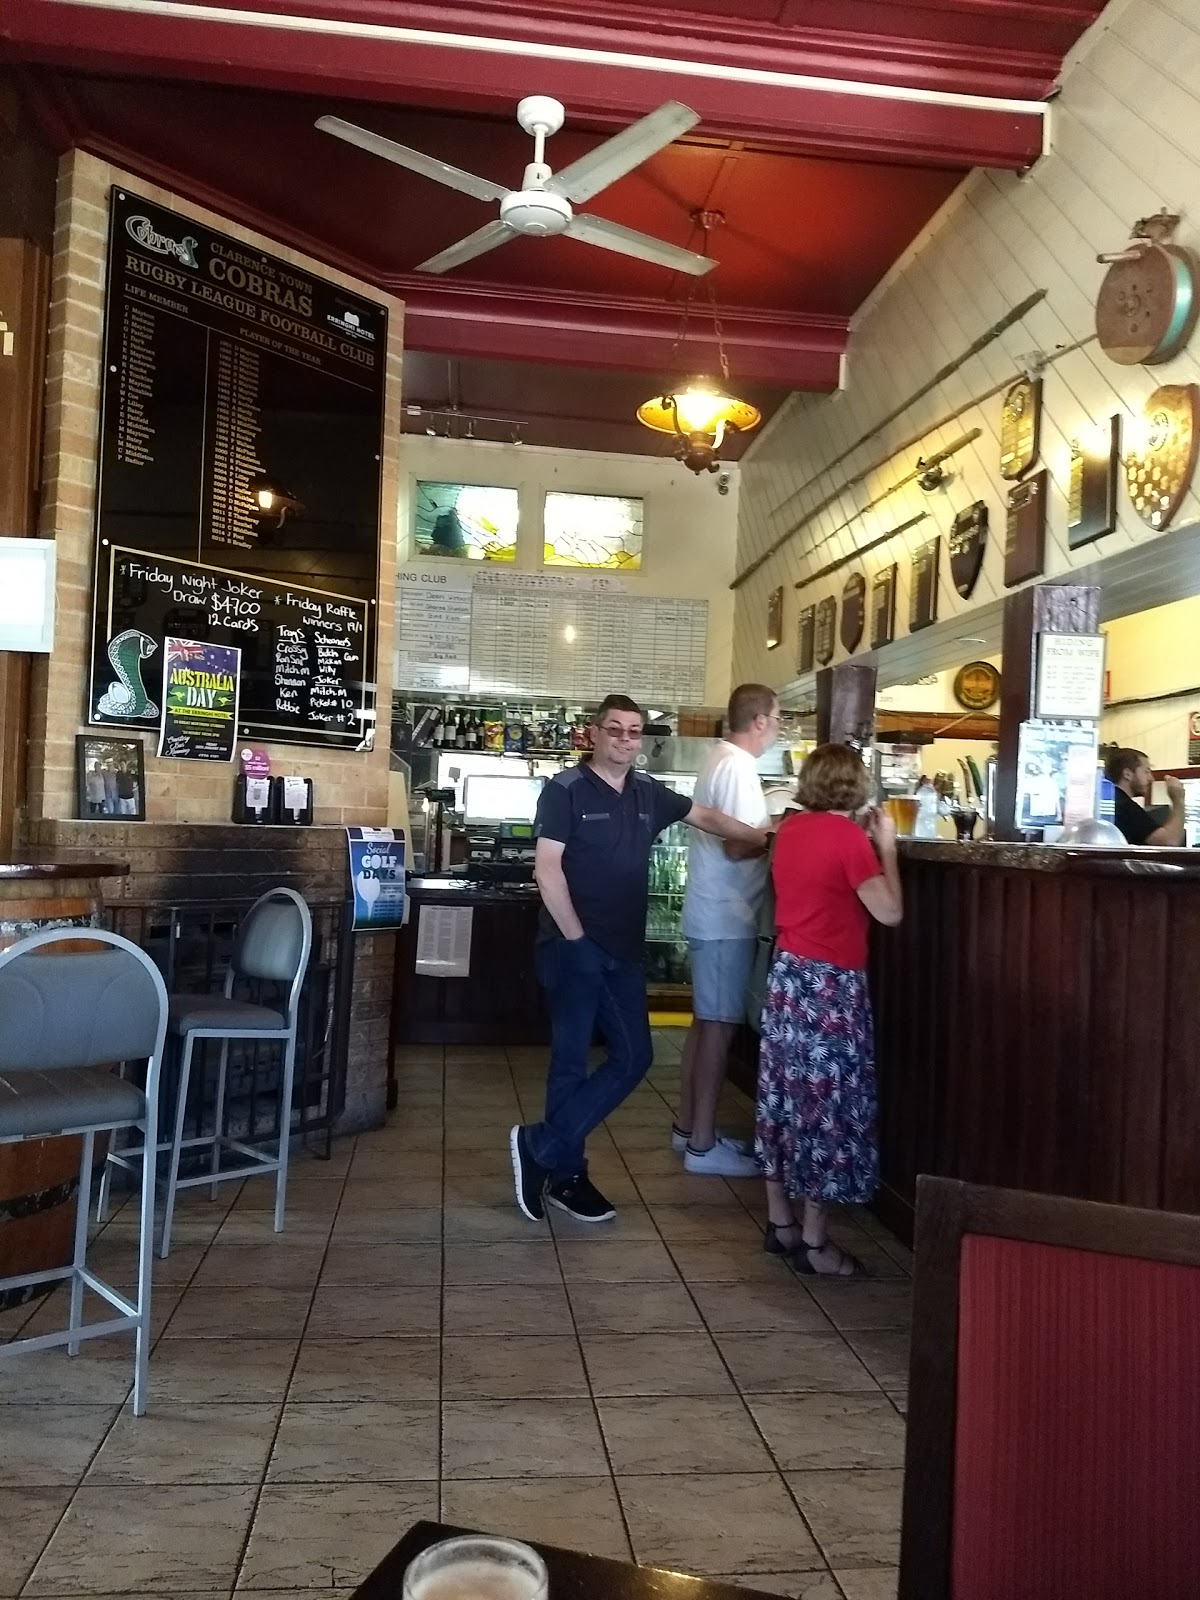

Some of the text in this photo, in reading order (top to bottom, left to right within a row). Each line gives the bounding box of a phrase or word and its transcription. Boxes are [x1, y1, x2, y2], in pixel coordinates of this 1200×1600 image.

[125, 215, 185, 257] Cobras
[210, 242, 312, 295] CLARENCE TOWN
[209, 258, 312, 318] COBRAS
[125, 284, 189, 314] LIFE MEMBER
[125, 255, 375, 367] RUGBY LEAGUE FOOTBALL CLUB
[356, 327, 376, 340] HOTEL
[240, 328, 321, 365] PLAYER OF THE YEAR
[125, 449, 154, 462] Middleton
[126, 442, 149, 454] Maytom
[130, 563, 264, 600] Friday Night Joker
[421, 573, 447, 583] CLUB
[173, 591, 261, 616] Draw $4700
[286, 592, 358, 620] Friday Raffle
[209, 613, 260, 632] 12 Cards
[347, 621, 363, 633] 19/1
[276, 624, 306, 644] Trays
[314, 631, 351, 647] Schooners
[1054, 637, 1093, 647] HIDING
[276, 643, 309, 661] Crossy
[1046, 647, 1100, 657] FROM WIFE
[170, 667, 235, 692] AUSTRALIA
[311, 674, 343, 686] Joker
[187, 686, 217, 709] DAY
[280, 687, 299, 698] Ken
[308, 711, 335, 722] Joker
[366, 842, 392, 855] Social
[361, 855, 398, 870] GOLF
[363, 869, 397, 880] DAYS
